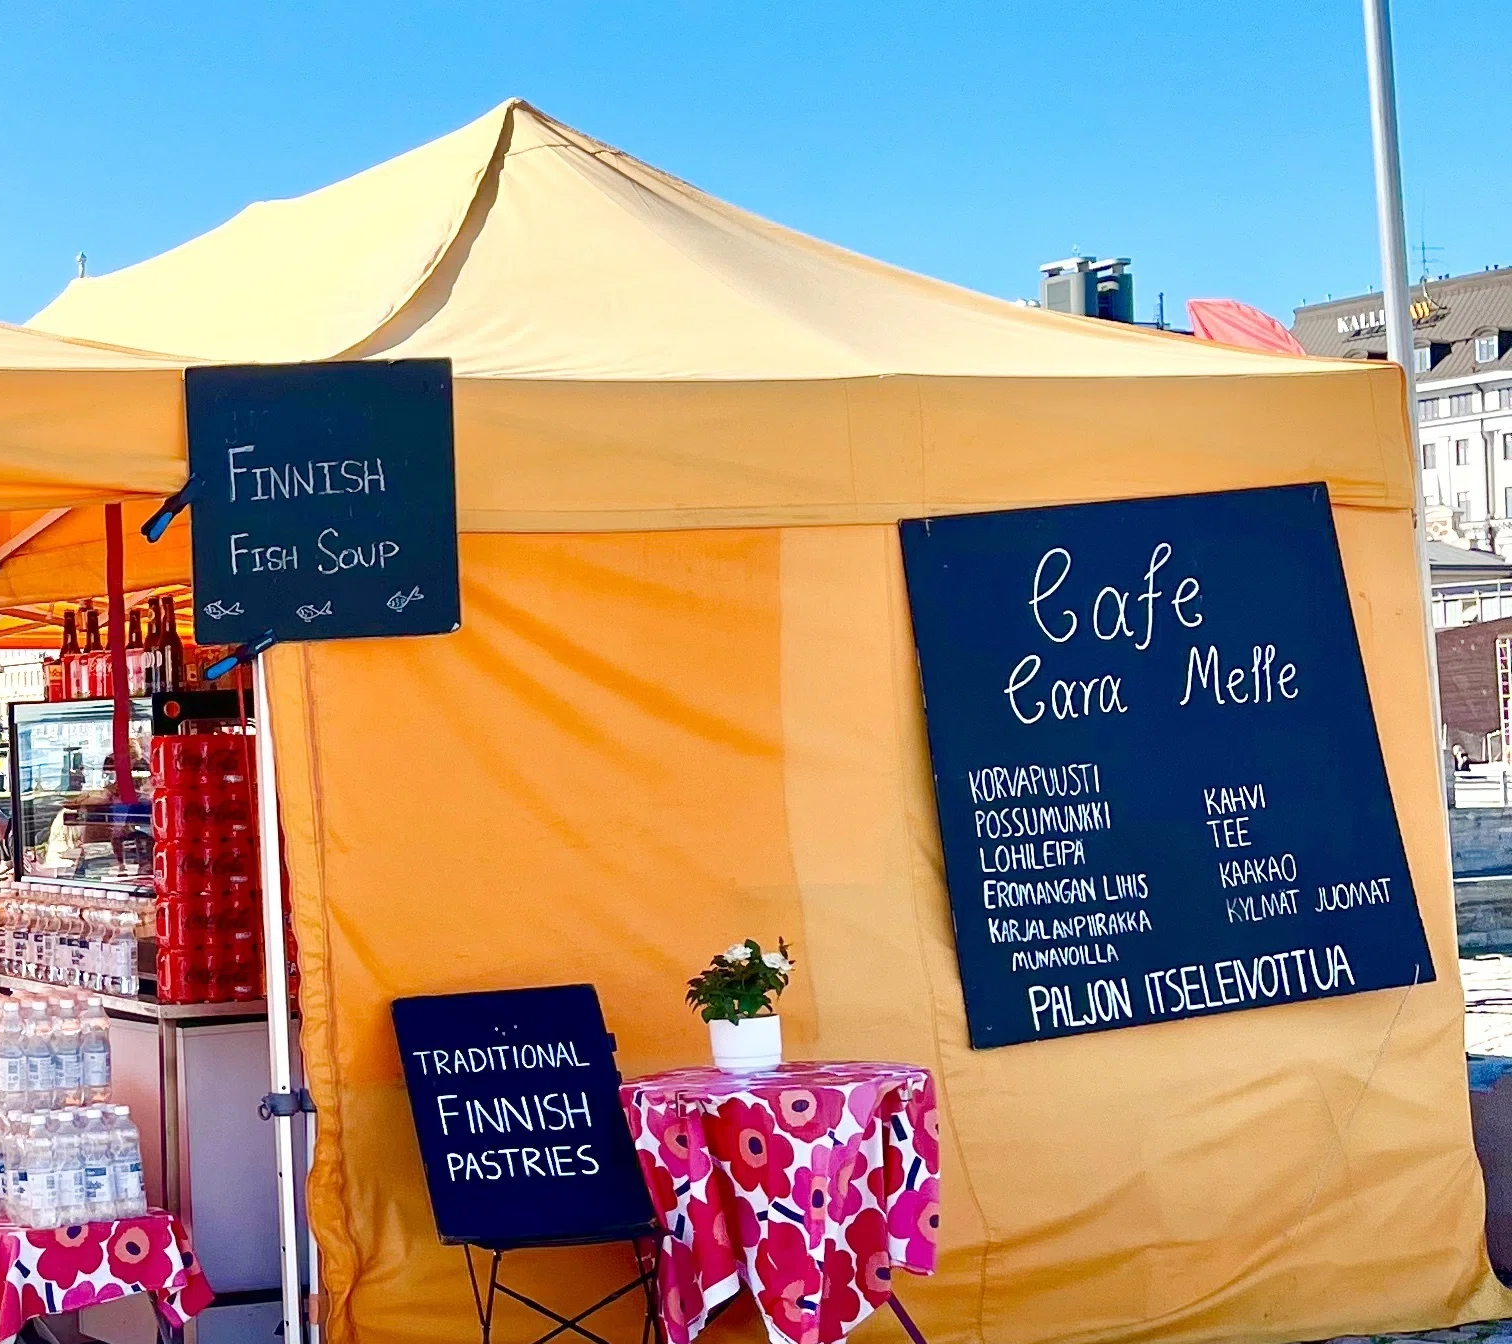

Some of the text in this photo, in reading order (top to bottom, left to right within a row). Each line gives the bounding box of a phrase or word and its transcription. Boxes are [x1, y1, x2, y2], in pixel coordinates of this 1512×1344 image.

[228, 444, 386, 502] FINNISH
[230, 528, 400, 575] FISH SOUP
[1028, 542, 1204, 650] Cafe
[1003, 644, 1299, 724] Cara Melle
[968, 763, 1100, 804] KORVAPUUSTI
[1203, 783, 1266, 815] KAHVI
[975, 801, 1111, 839] POSSUMUNKKI
[1206, 816, 1252, 849] TEE
[1218, 853, 1297, 889] KAAKAO
[983, 873, 1149, 910] EROMANGAN LIHIS
[1226, 877, 1391, 924] KYLMÄT JUOMAT
[987, 909, 1153, 944] KARJALANPIIRAKKA
[1012, 943, 1120, 972] MUNAVOILLA
[1027, 944, 1356, 1032] PALJON ITSELEIVOTTUA
[412, 1041, 591, 1076] TRADITIONAL
[436, 1091, 592, 1136] FINNISH
[446, 1144, 600, 1182] PASTRIES
